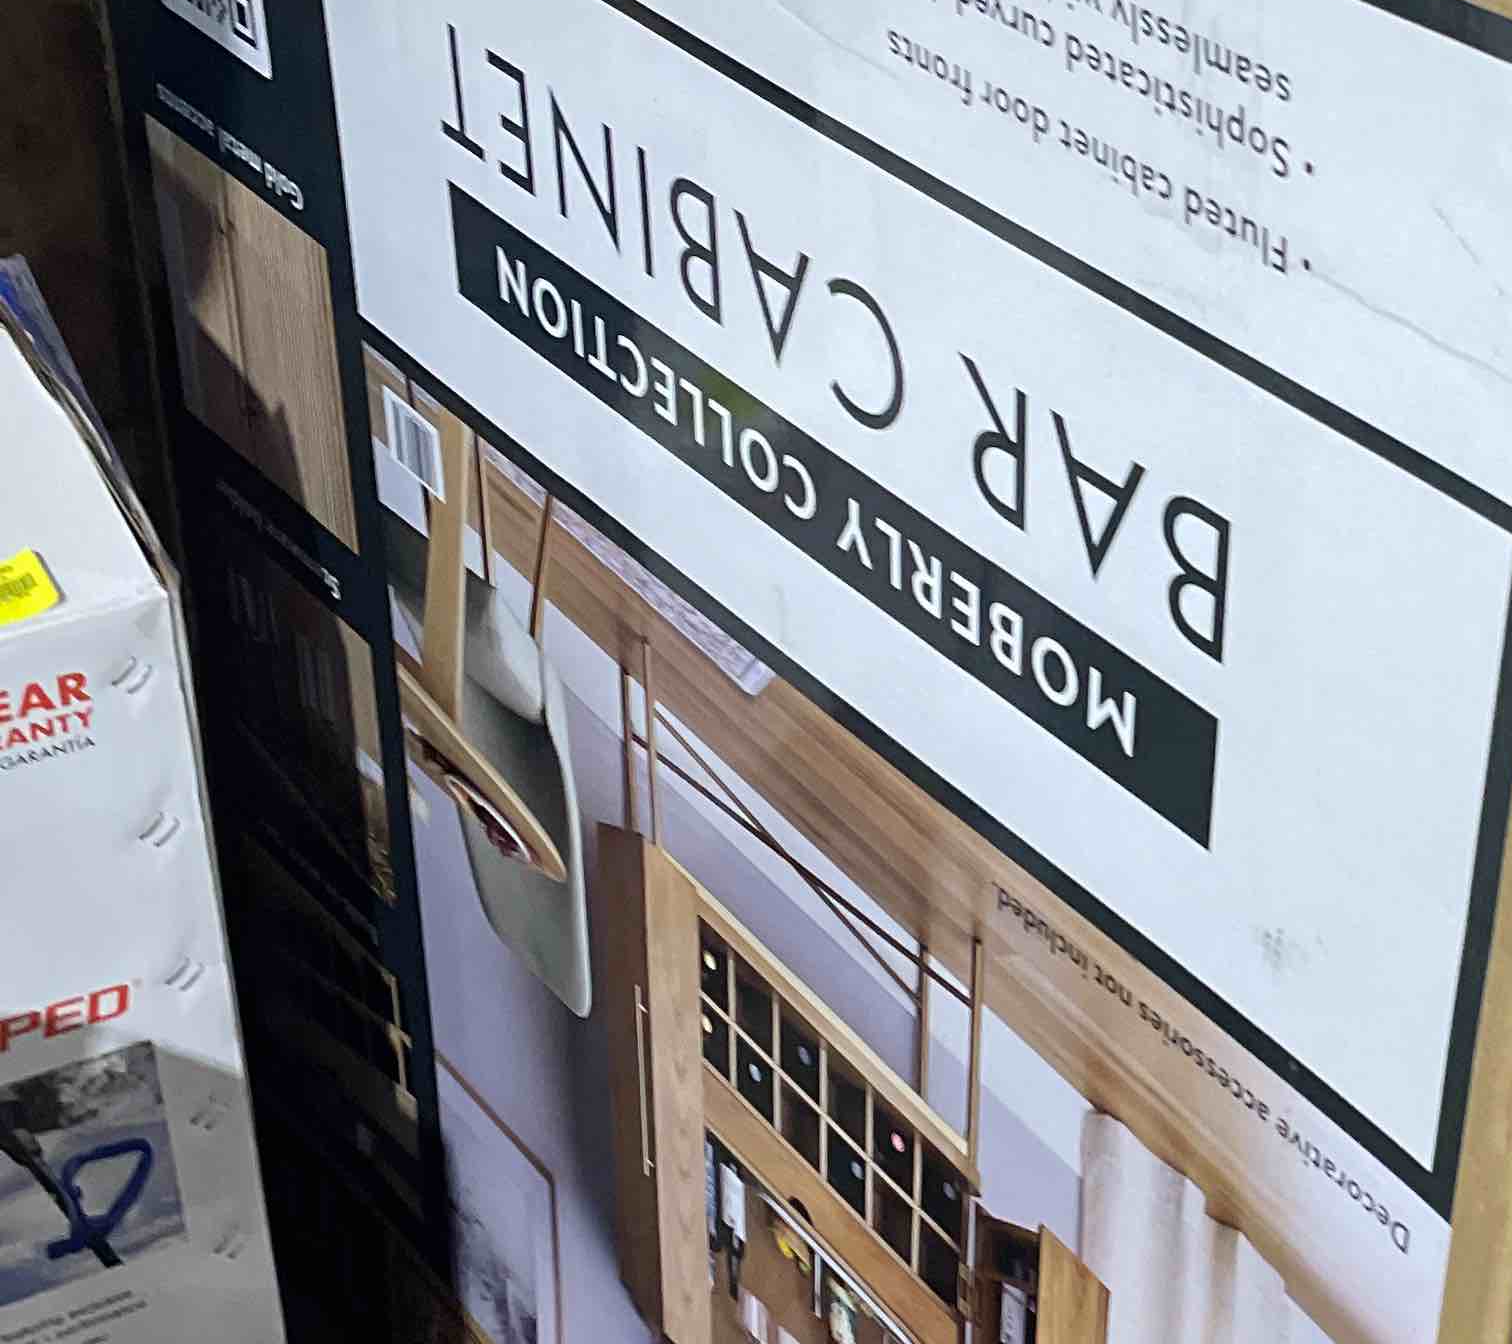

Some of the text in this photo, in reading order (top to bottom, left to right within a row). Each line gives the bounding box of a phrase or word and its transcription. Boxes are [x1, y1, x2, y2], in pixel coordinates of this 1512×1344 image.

[886, 28, 1289, 273] Fluted cabinet door fronts
[1063, 30, 1291, 177] Sophisticated
[439, 21, 1230, 666] BAR CABINET
[494, 243, 1138, 759] MOBERLY COLLECTION
[992, 880, 1412, 1255] Decorative accessories not included.
